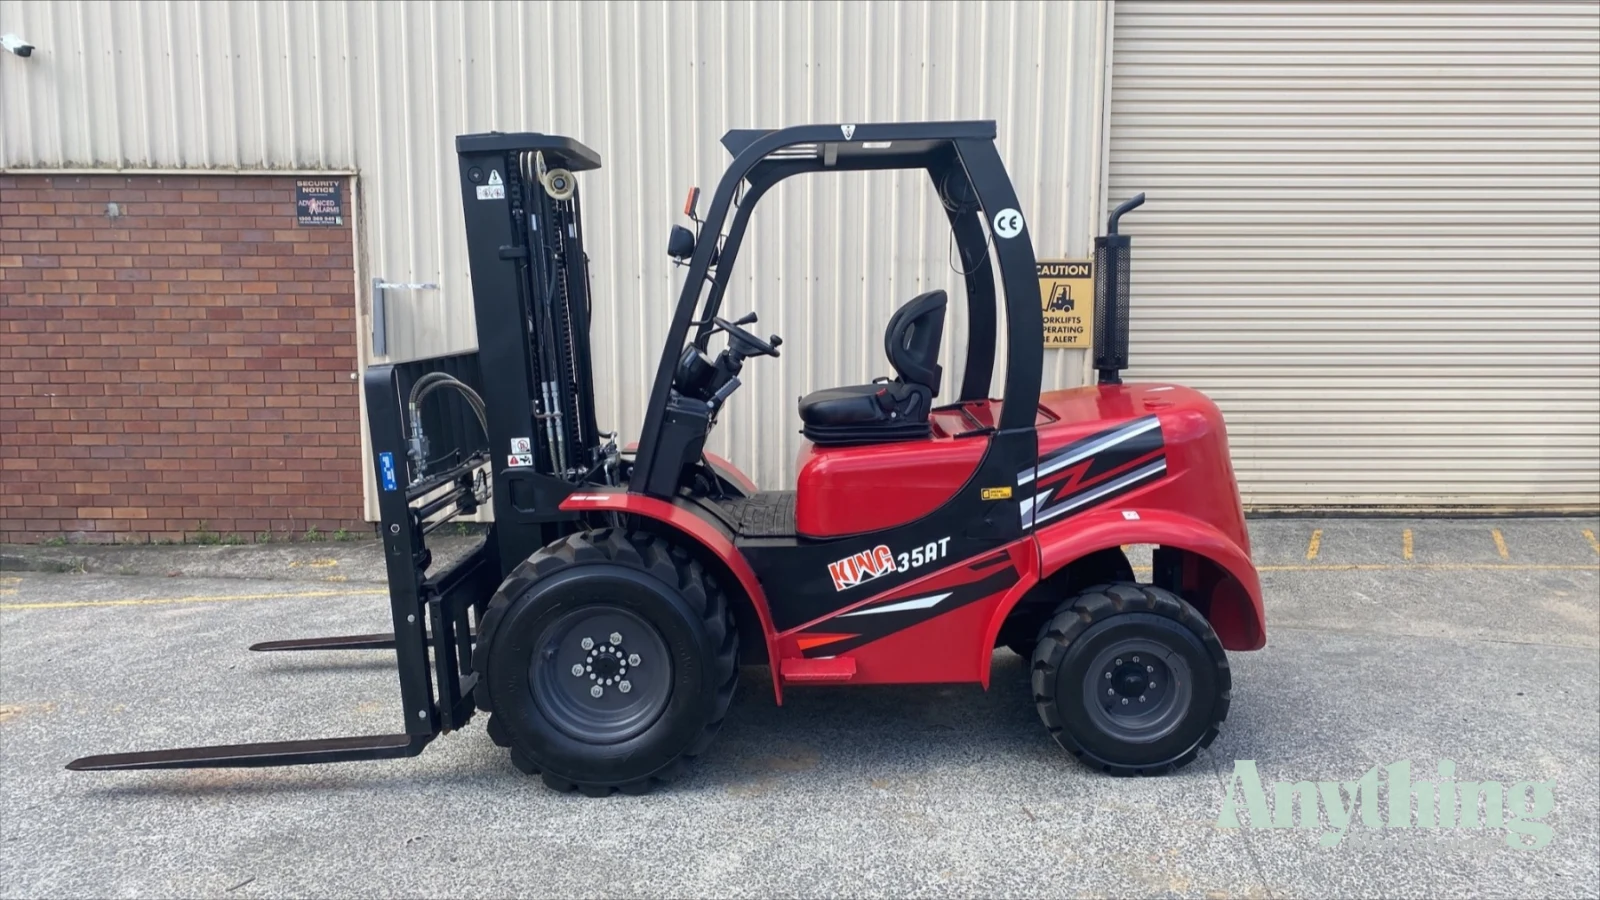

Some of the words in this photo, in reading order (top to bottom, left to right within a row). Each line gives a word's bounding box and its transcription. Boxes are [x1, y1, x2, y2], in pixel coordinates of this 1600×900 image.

[997, 215, 1017, 231] CE
[1036, 264, 1089, 276] CAUTION
[1043, 316, 1082, 324] ORKLIFTS
[1043, 326, 1084, 334] PERATING
[1043, 335, 1050, 343] E
[1053, 335, 1078, 343] ALERT
[827, 544, 897, 592] KING
[897, 536, 951, 573] 35AT
